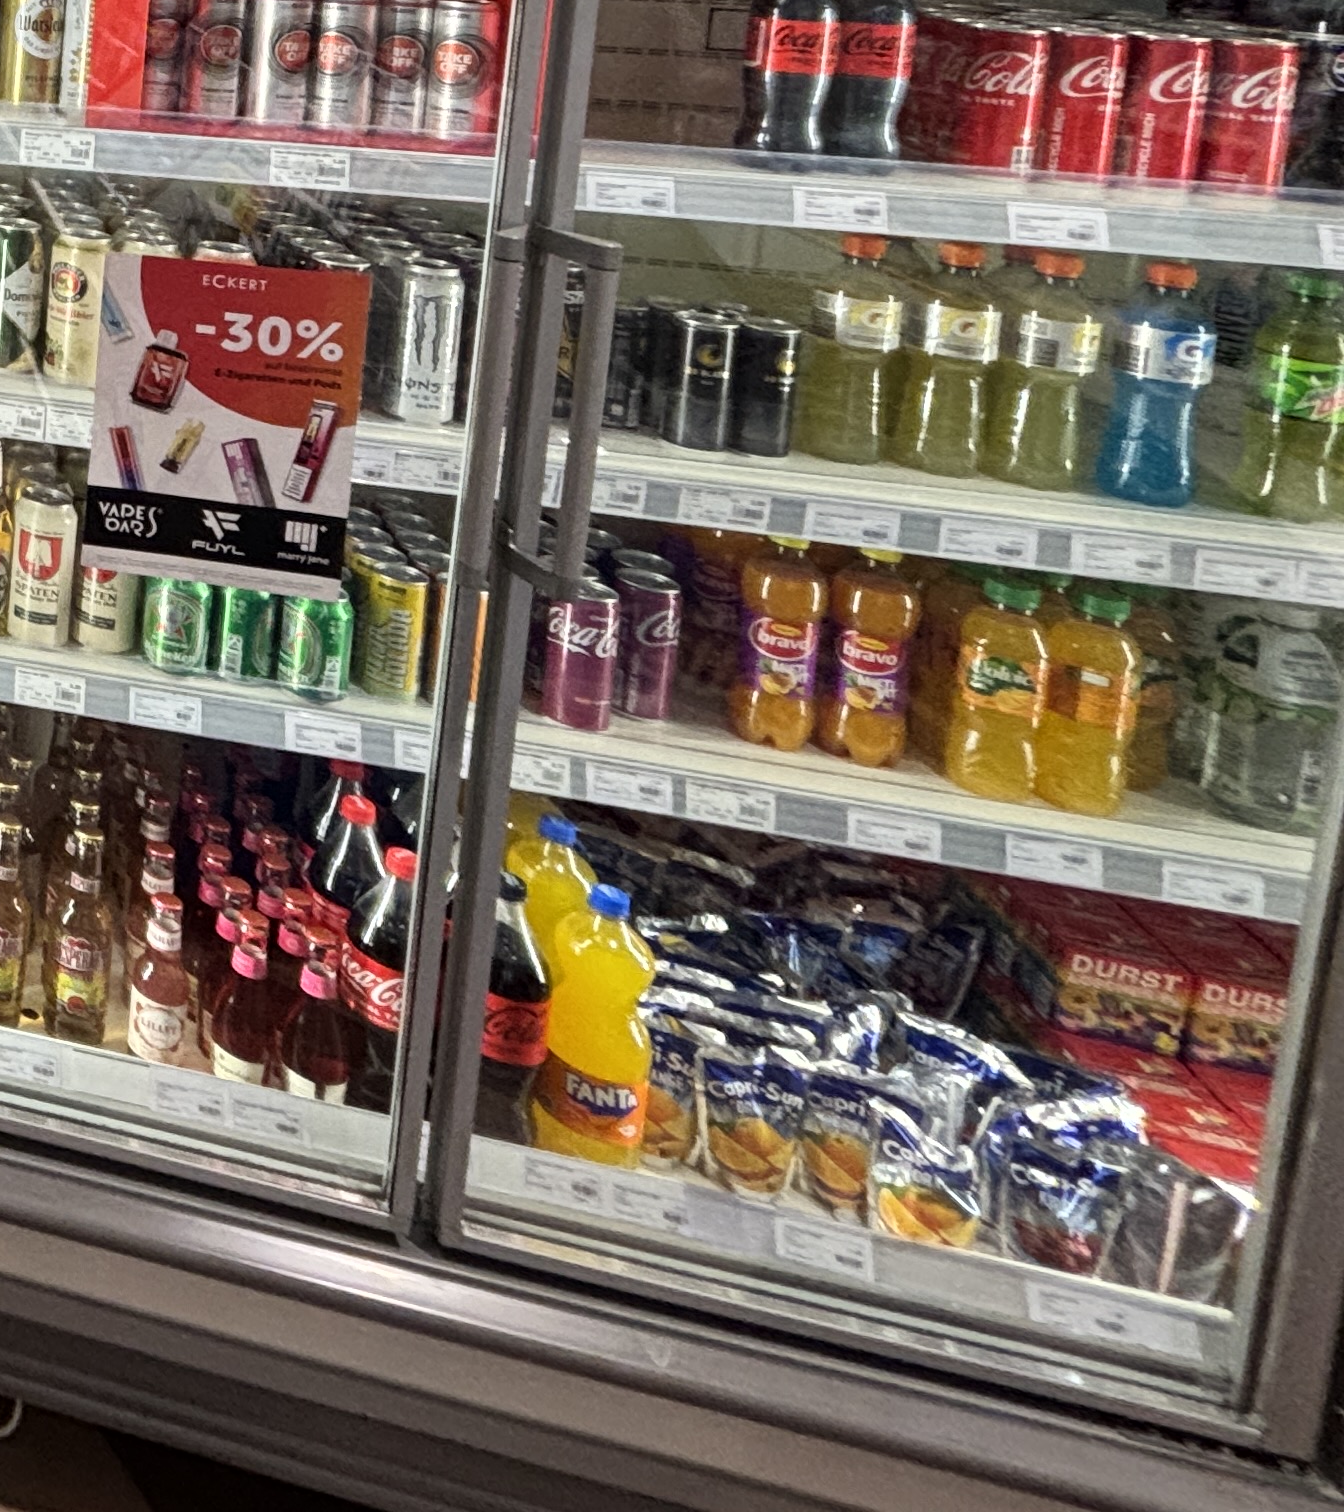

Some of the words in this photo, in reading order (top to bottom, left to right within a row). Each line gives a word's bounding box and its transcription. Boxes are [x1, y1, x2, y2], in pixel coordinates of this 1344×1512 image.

[438, 51, 473, 65] TAKE
[441, 62, 468, 75] OFF
[964, 49, 1040, 95] Cola
[202, 274, 269, 292] ECKERT
[195, 311, 344, 362] -30%
[277, 550, 304, 564] marry
[306, 552, 330, 566] jane
[14, 579, 59, 599] SPATEN
[758, 631, 808, 651] bravo
[842, 643, 899, 666] bravo
[1071, 953, 1183, 993] DURST
[565, 1072, 638, 1110] FANTA
[709, 1081, 805, 1112] Capri-Sun
